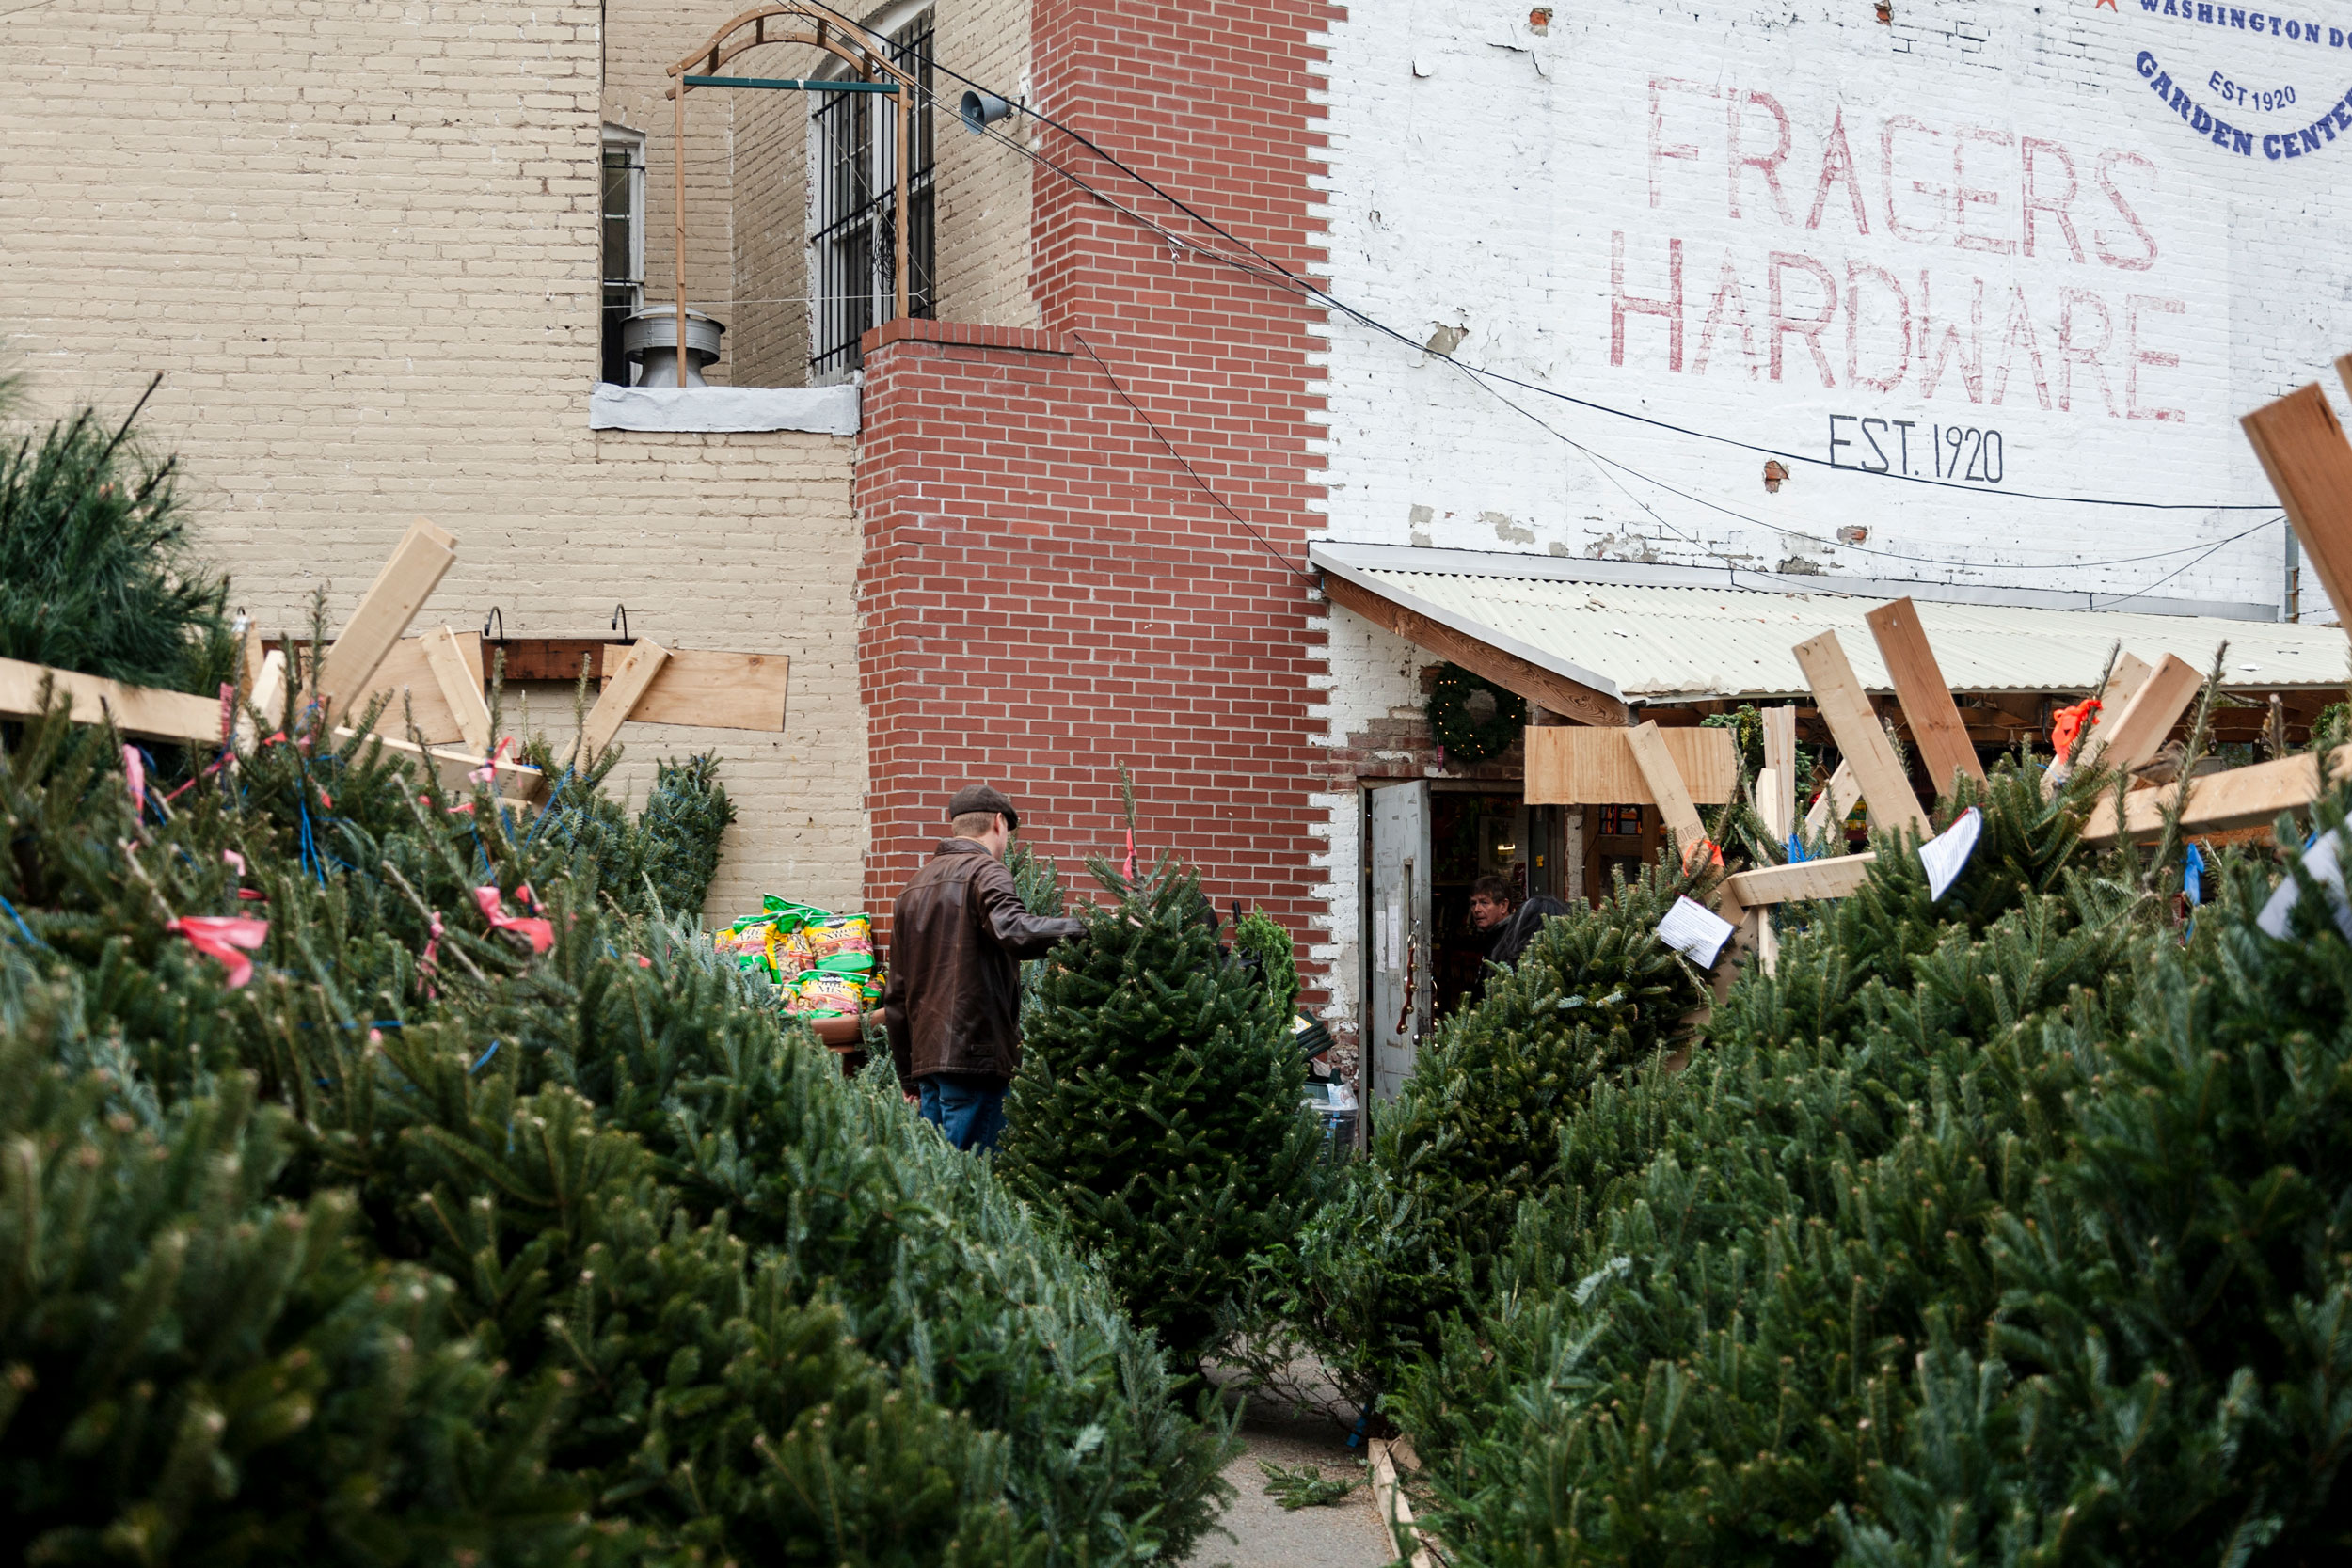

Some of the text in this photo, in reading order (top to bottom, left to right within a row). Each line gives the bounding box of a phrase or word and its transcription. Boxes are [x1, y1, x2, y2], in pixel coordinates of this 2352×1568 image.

[2140, 0, 2320, 43] WASHINGTON
[2137, 50, 2352, 160] GARDEN CENTE
[2208, 70, 2296, 111] EST 1920
[1648, 76, 2159, 271] FRAGERS
[1610, 230, 2185, 422] HARDWARE
[1829, 414, 2003, 483] EST. 1920
